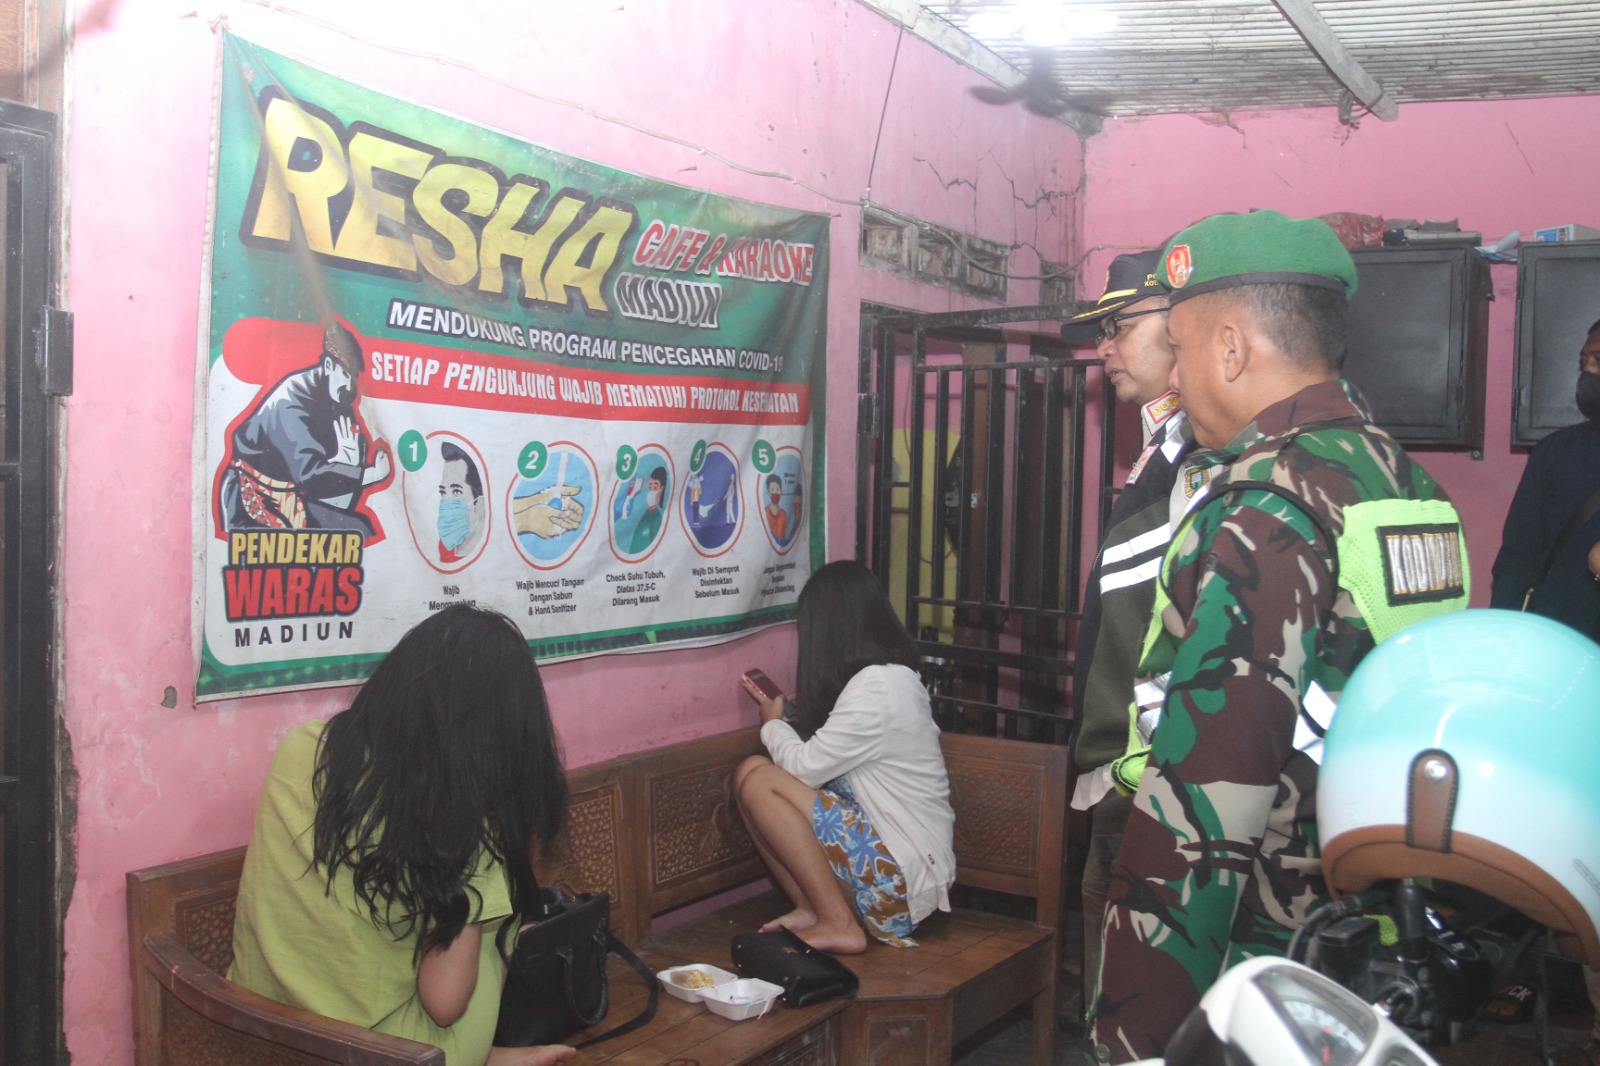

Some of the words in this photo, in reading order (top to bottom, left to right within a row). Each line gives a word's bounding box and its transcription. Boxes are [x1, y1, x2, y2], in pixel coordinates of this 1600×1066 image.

[252, 97, 633, 312] RESHA
[632, 219, 710, 273] CAFE
[696, 233, 728, 276] &
[716, 238, 815, 287] KARAOKE
[614, 272, 723, 329] MADIUN
[389, 302, 527, 348] MENDUKUNG
[529, 328, 617, 360] PROGRAM
[621, 342, 736, 368] PENCEGAHAN
[738, 351, 784, 373] COVID-19
[371, 351, 440, 386] SETIAP
[443, 362, 557, 400] PENGUNJUNG
[559, 376, 603, 405] WAJIB
[605, 382, 687, 409] MEMATUHI
[690, 386, 740, 412] PROTOKOL
[408, 440, 418, 462] 1
[525, 450, 539, 470] 2
[693, 448, 702, 465] 4
[758, 448, 770, 466] 5
[621, 453, 633, 472] 3
[231, 532, 362, 565] PENDEKAR
[606, 573, 626, 583] Check
[627, 571, 643, 581] Suhu
[692, 568, 705, 577] Wajib
[707, 567, 714, 576] Di
[714, 565, 740, 576] Semprot
[442, 585, 460, 597] Wajib
[516, 580, 534, 591] Wajib
[535, 579, 560, 589] Mencuci
[561, 578, 585, 589] Tangan
[616, 584, 635, 594] Diatas
[700, 577, 733, 587] Disinfektan
[225, 567, 362, 619] WARAS
[529, 593, 552, 604] Dengan
[553, 592, 573, 601] Sabun
[612, 597, 638, 607] Dilarang
[639, 594, 660, 604] Masuk
[694, 589, 720, 599] Sebelum
[721, 587, 740, 597] Masuk
[535, 606, 551, 615] Hand
[551, 604, 577, 614] Sanitizer
[234, 621, 354, 648] MADIUN
